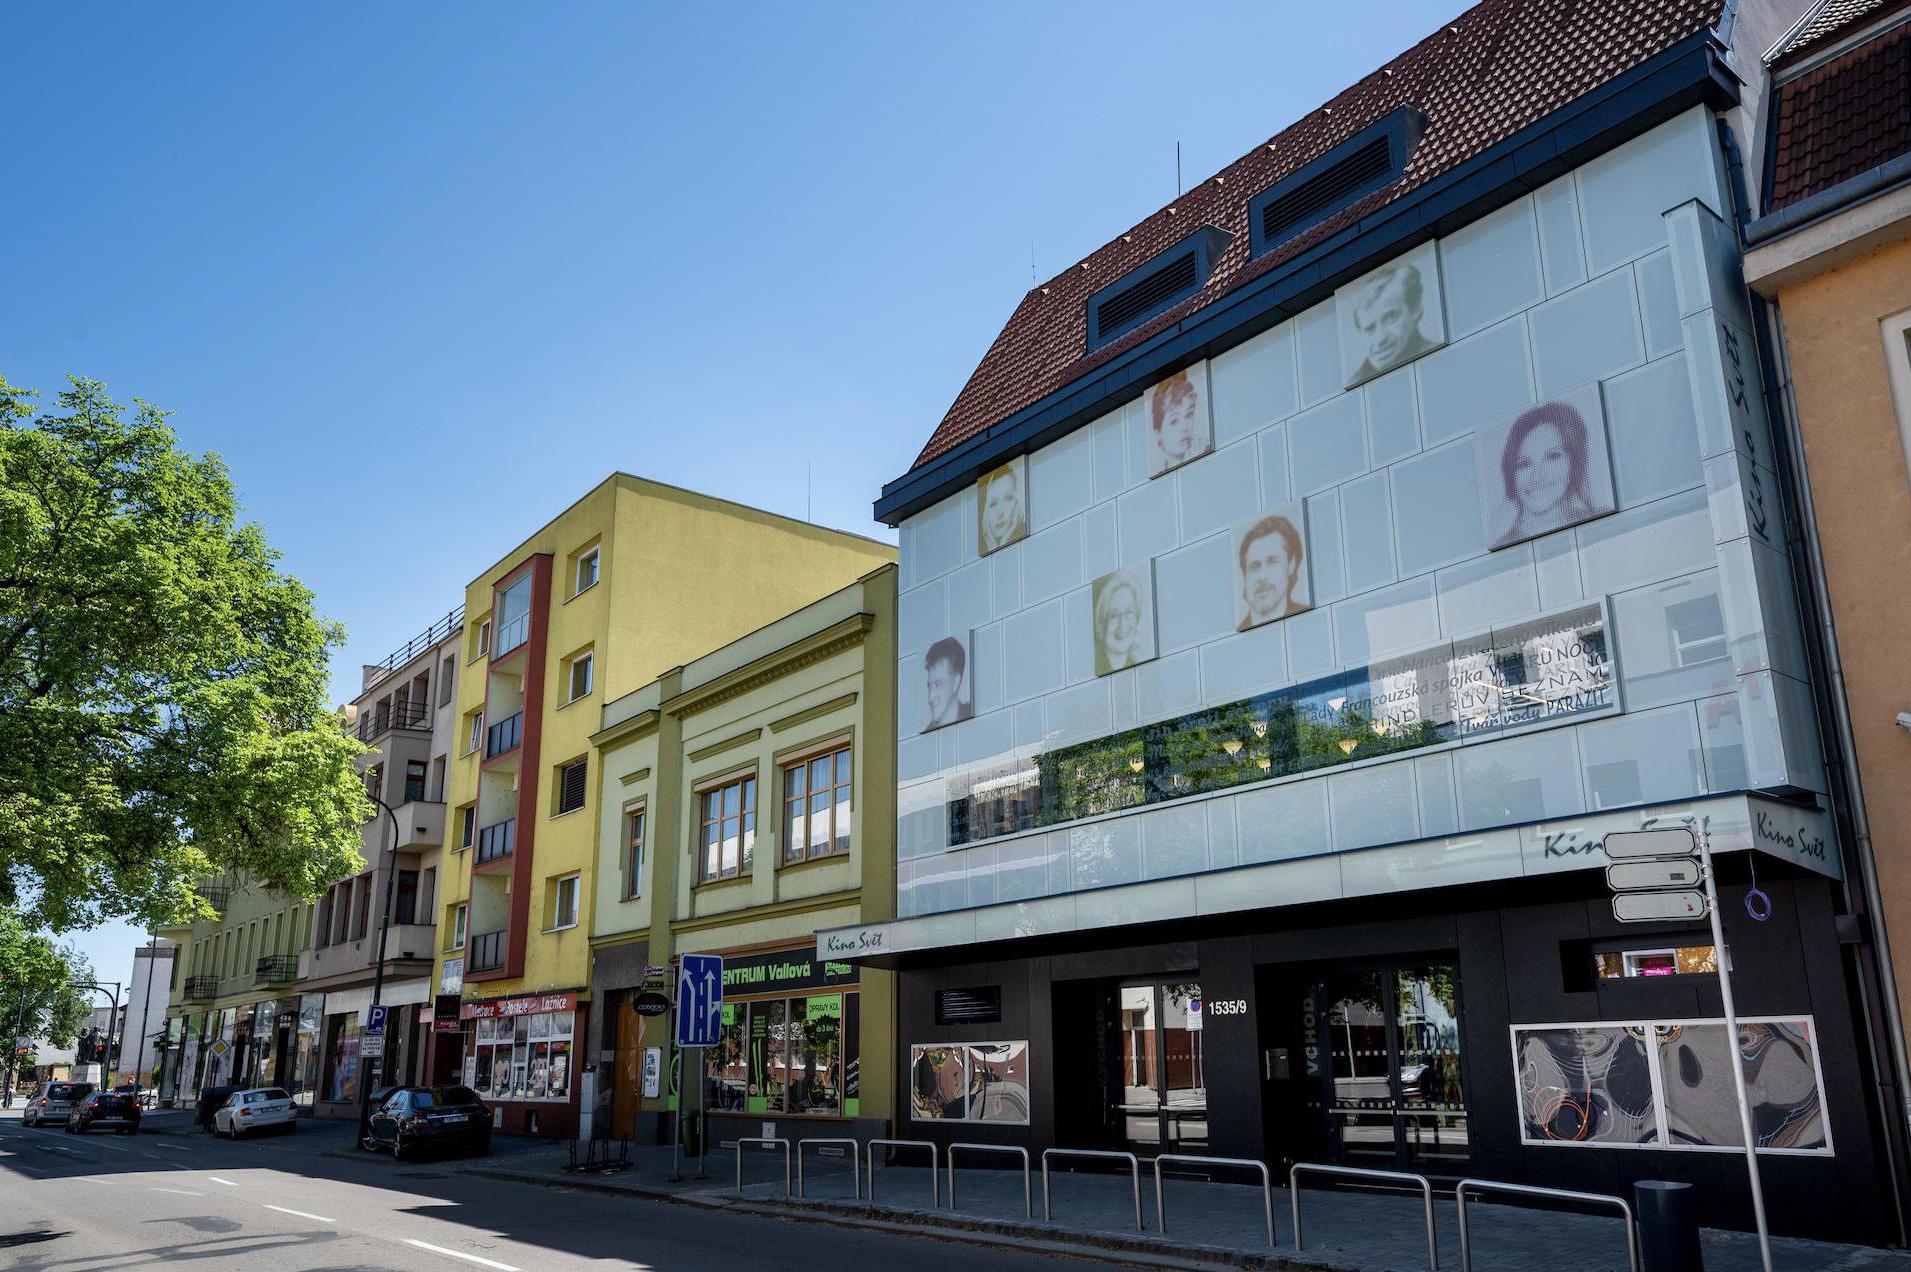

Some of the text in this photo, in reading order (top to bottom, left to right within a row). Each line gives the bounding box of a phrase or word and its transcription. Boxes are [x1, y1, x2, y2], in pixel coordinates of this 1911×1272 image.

[1746, 431, 1770, 541] Kino
[1545, 688, 1606, 716] PARAZIT
[1756, 811, 1795, 848] Kino
[1544, 830, 1605, 859] Kin
[827, 931, 882, 951] Kino Svět
[722, 965, 766, 985] ENTRUM
[768, 960, 811, 980] Vallová
[371, 1008, 384, 1025] P
[1208, 999, 1248, 1016] 1535/9
